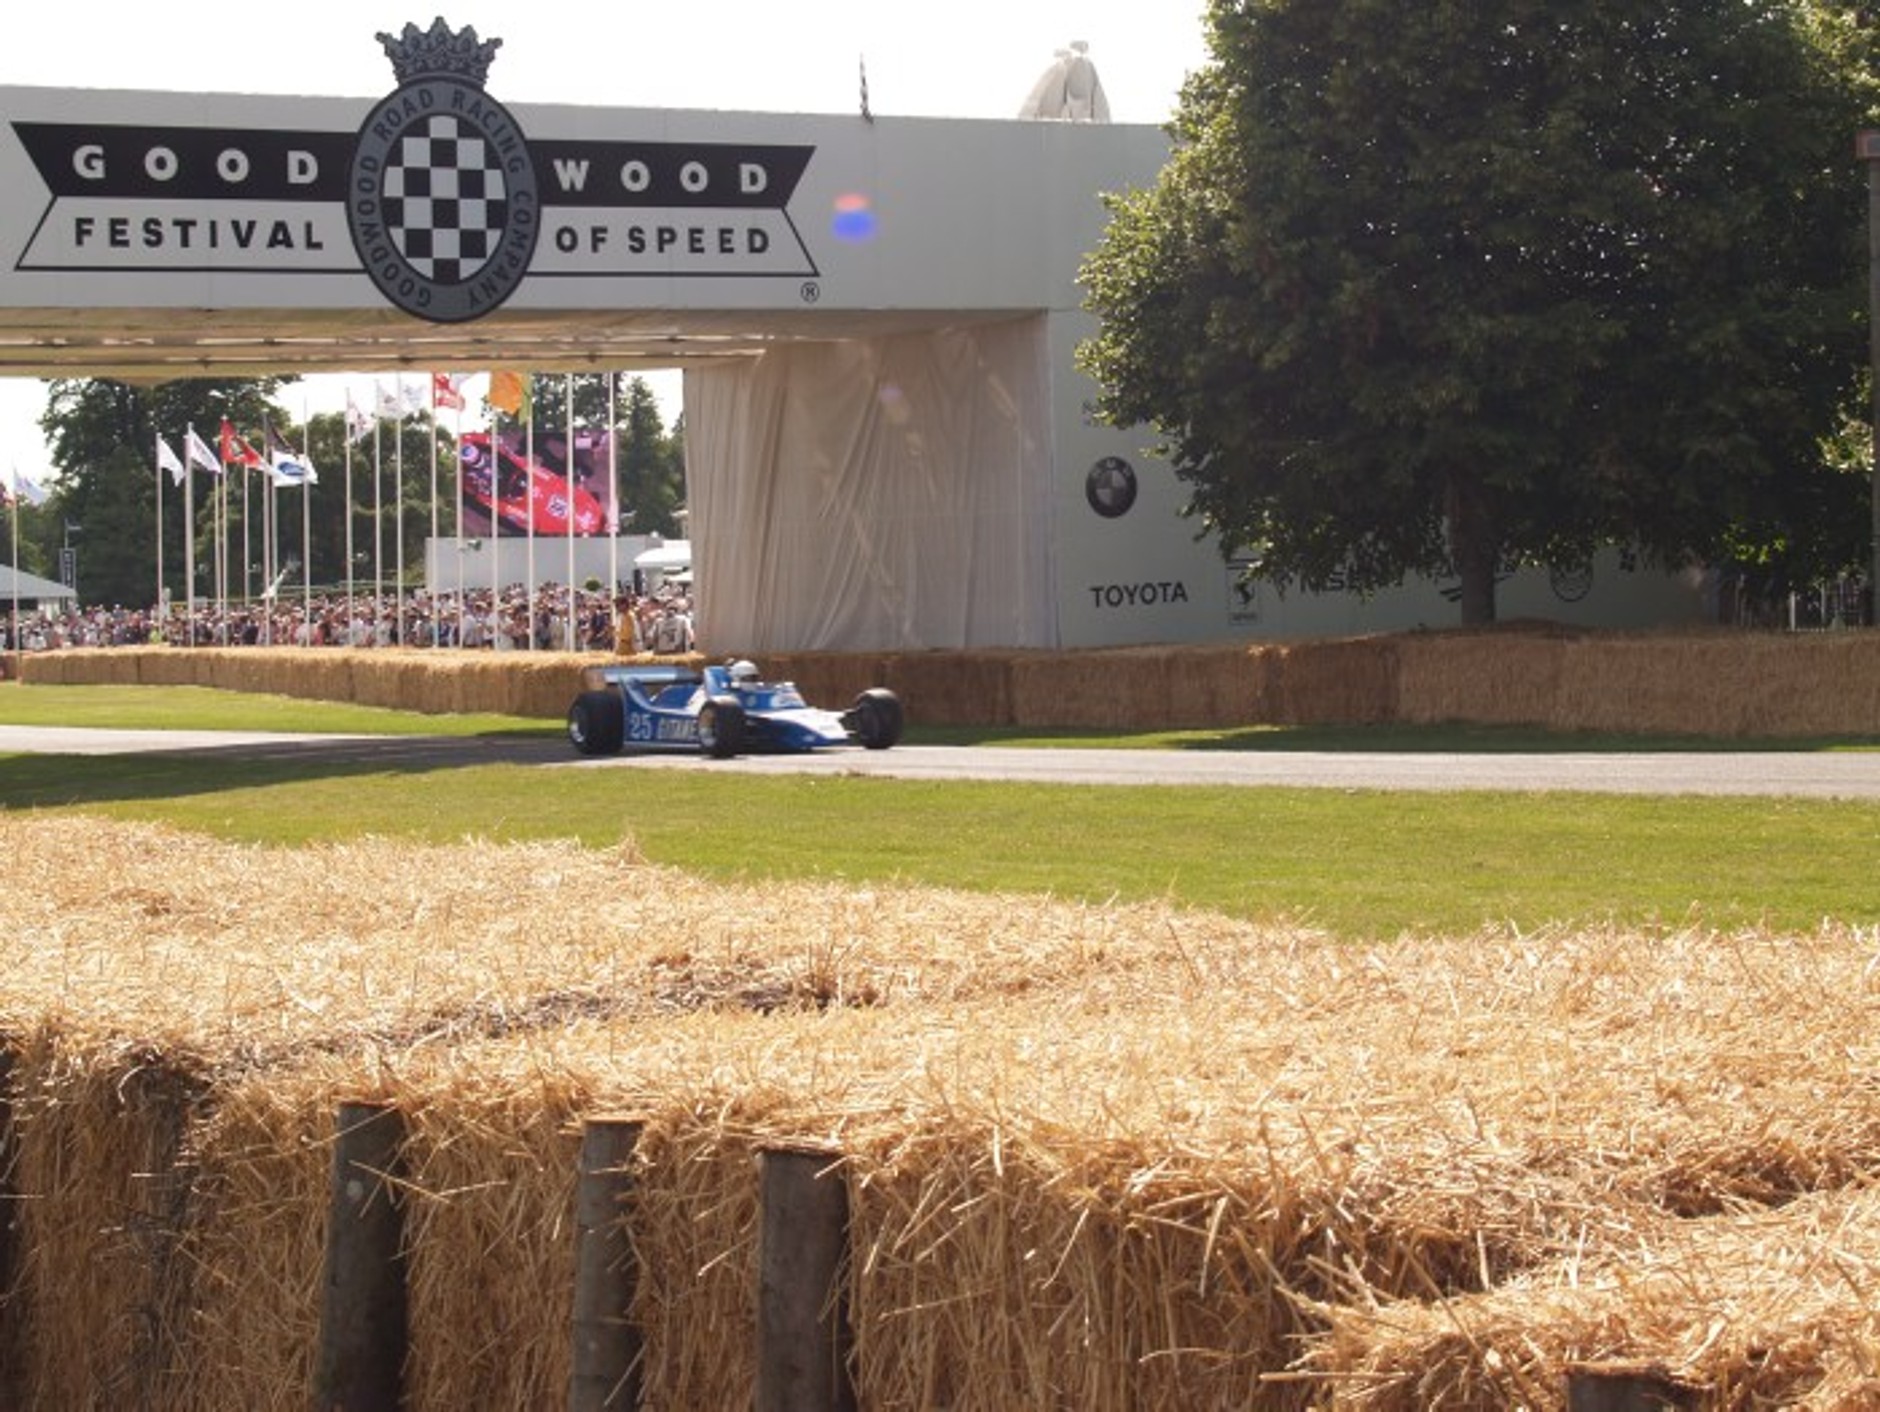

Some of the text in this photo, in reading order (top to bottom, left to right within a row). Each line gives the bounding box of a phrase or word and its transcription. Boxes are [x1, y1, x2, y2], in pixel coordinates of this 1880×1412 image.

[373, 87, 433, 143] ROAD
[451, 89, 526, 174] RACING
[72, 144, 768, 194] GOOD WOOD
[75, 217, 324, 251] FESTIVAL
[467, 190, 534, 309] COMPANY
[555, 225, 770, 253] OF SPEED
[1089, 581, 1189, 609] TOYOTA
[629, 711, 652, 740] 25
